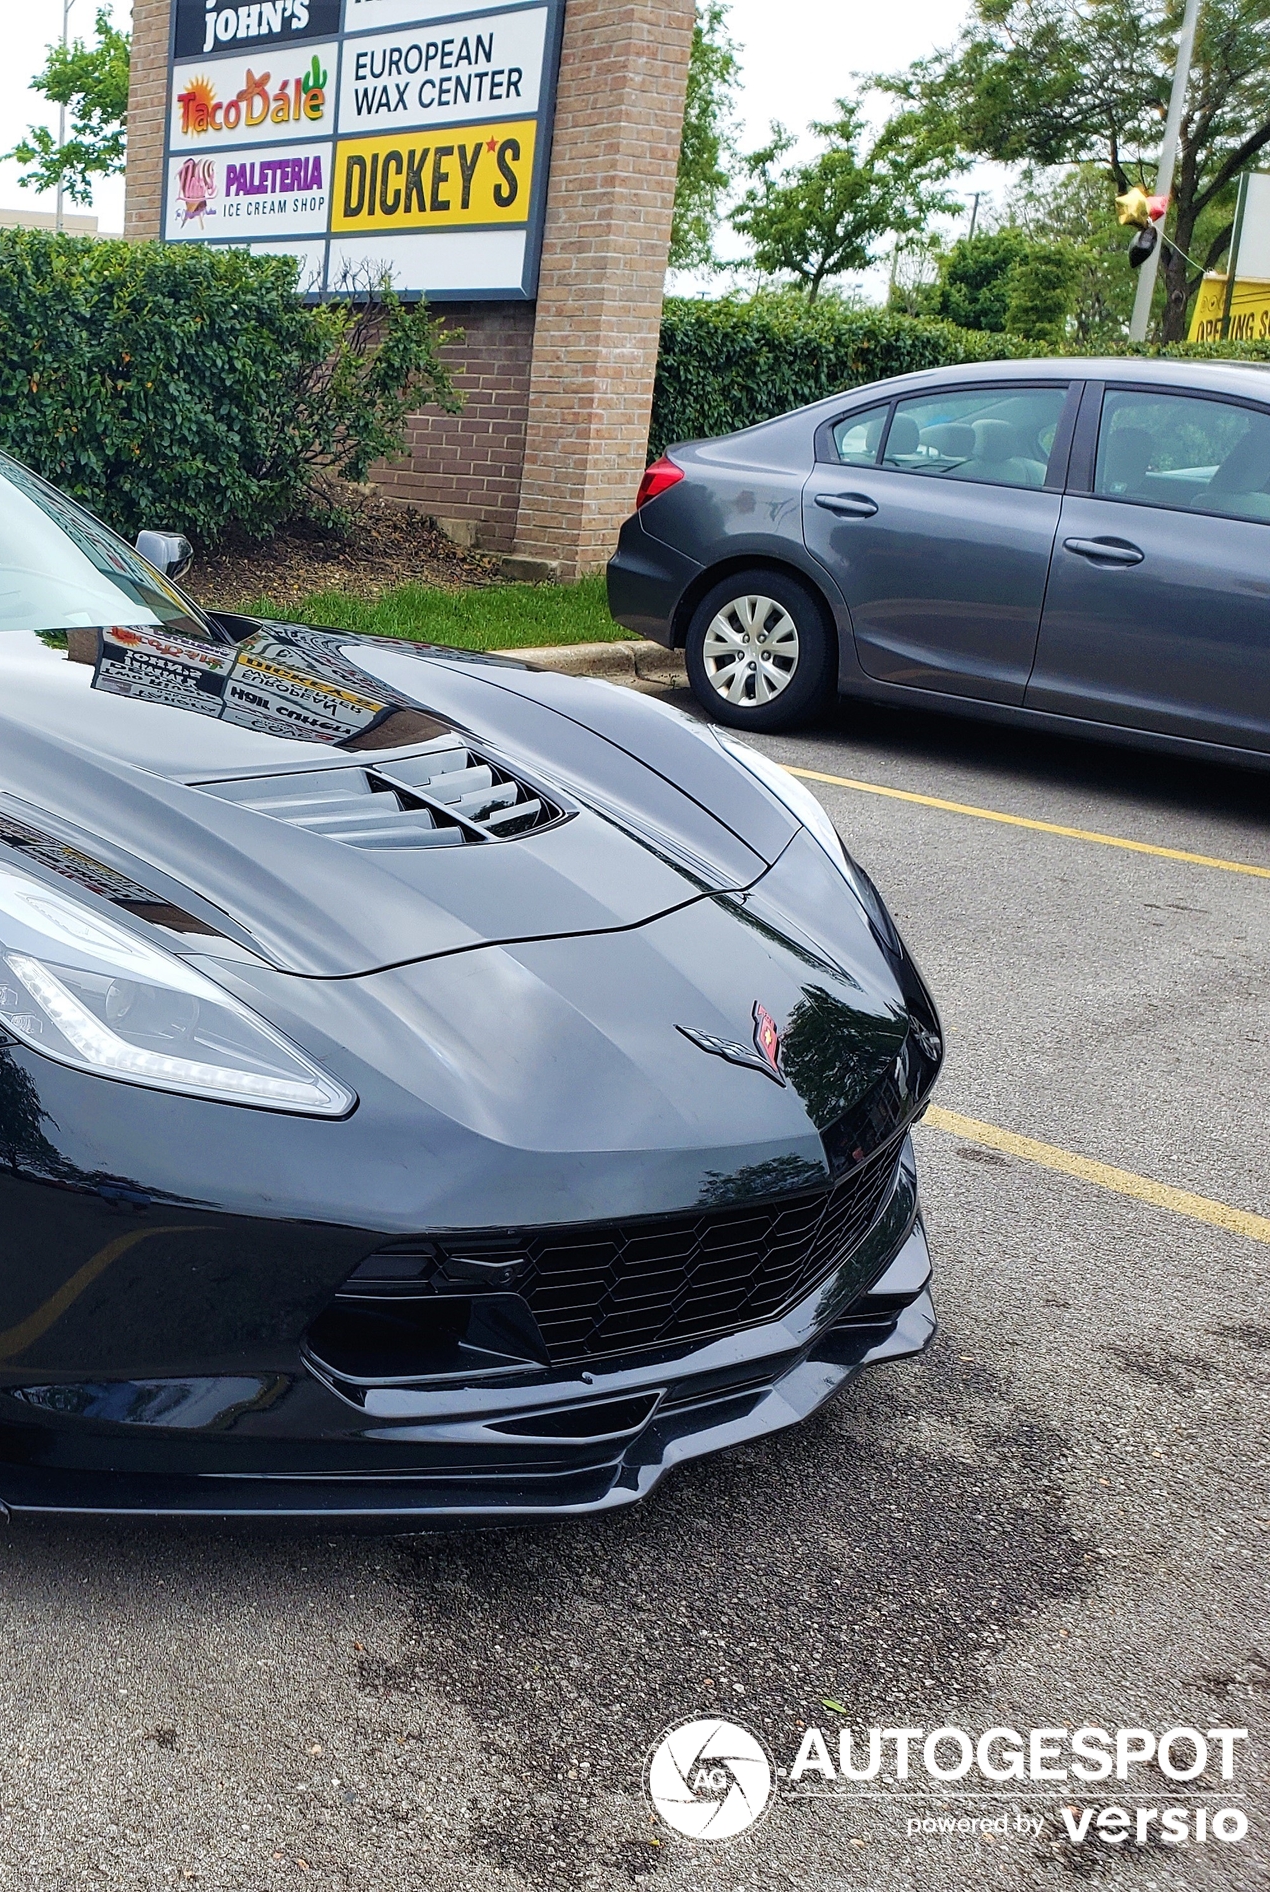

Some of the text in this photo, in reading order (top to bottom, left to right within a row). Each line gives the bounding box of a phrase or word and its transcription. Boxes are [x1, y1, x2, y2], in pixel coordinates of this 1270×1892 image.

[203, 0, 309, 52] JOHN'S
[355, 32, 494, 81] EUROPEAN
[354, 67, 523, 116] WAX CENTER
[225, 155, 323, 197] PALETERIA
[343, 137, 521, 217] DICKEY'S
[223, 202, 241, 217] ICE
[246, 199, 287, 216] CREAM
[293, 196, 325, 212] SHOP
[1197, 312, 1255, 341] OPEING
